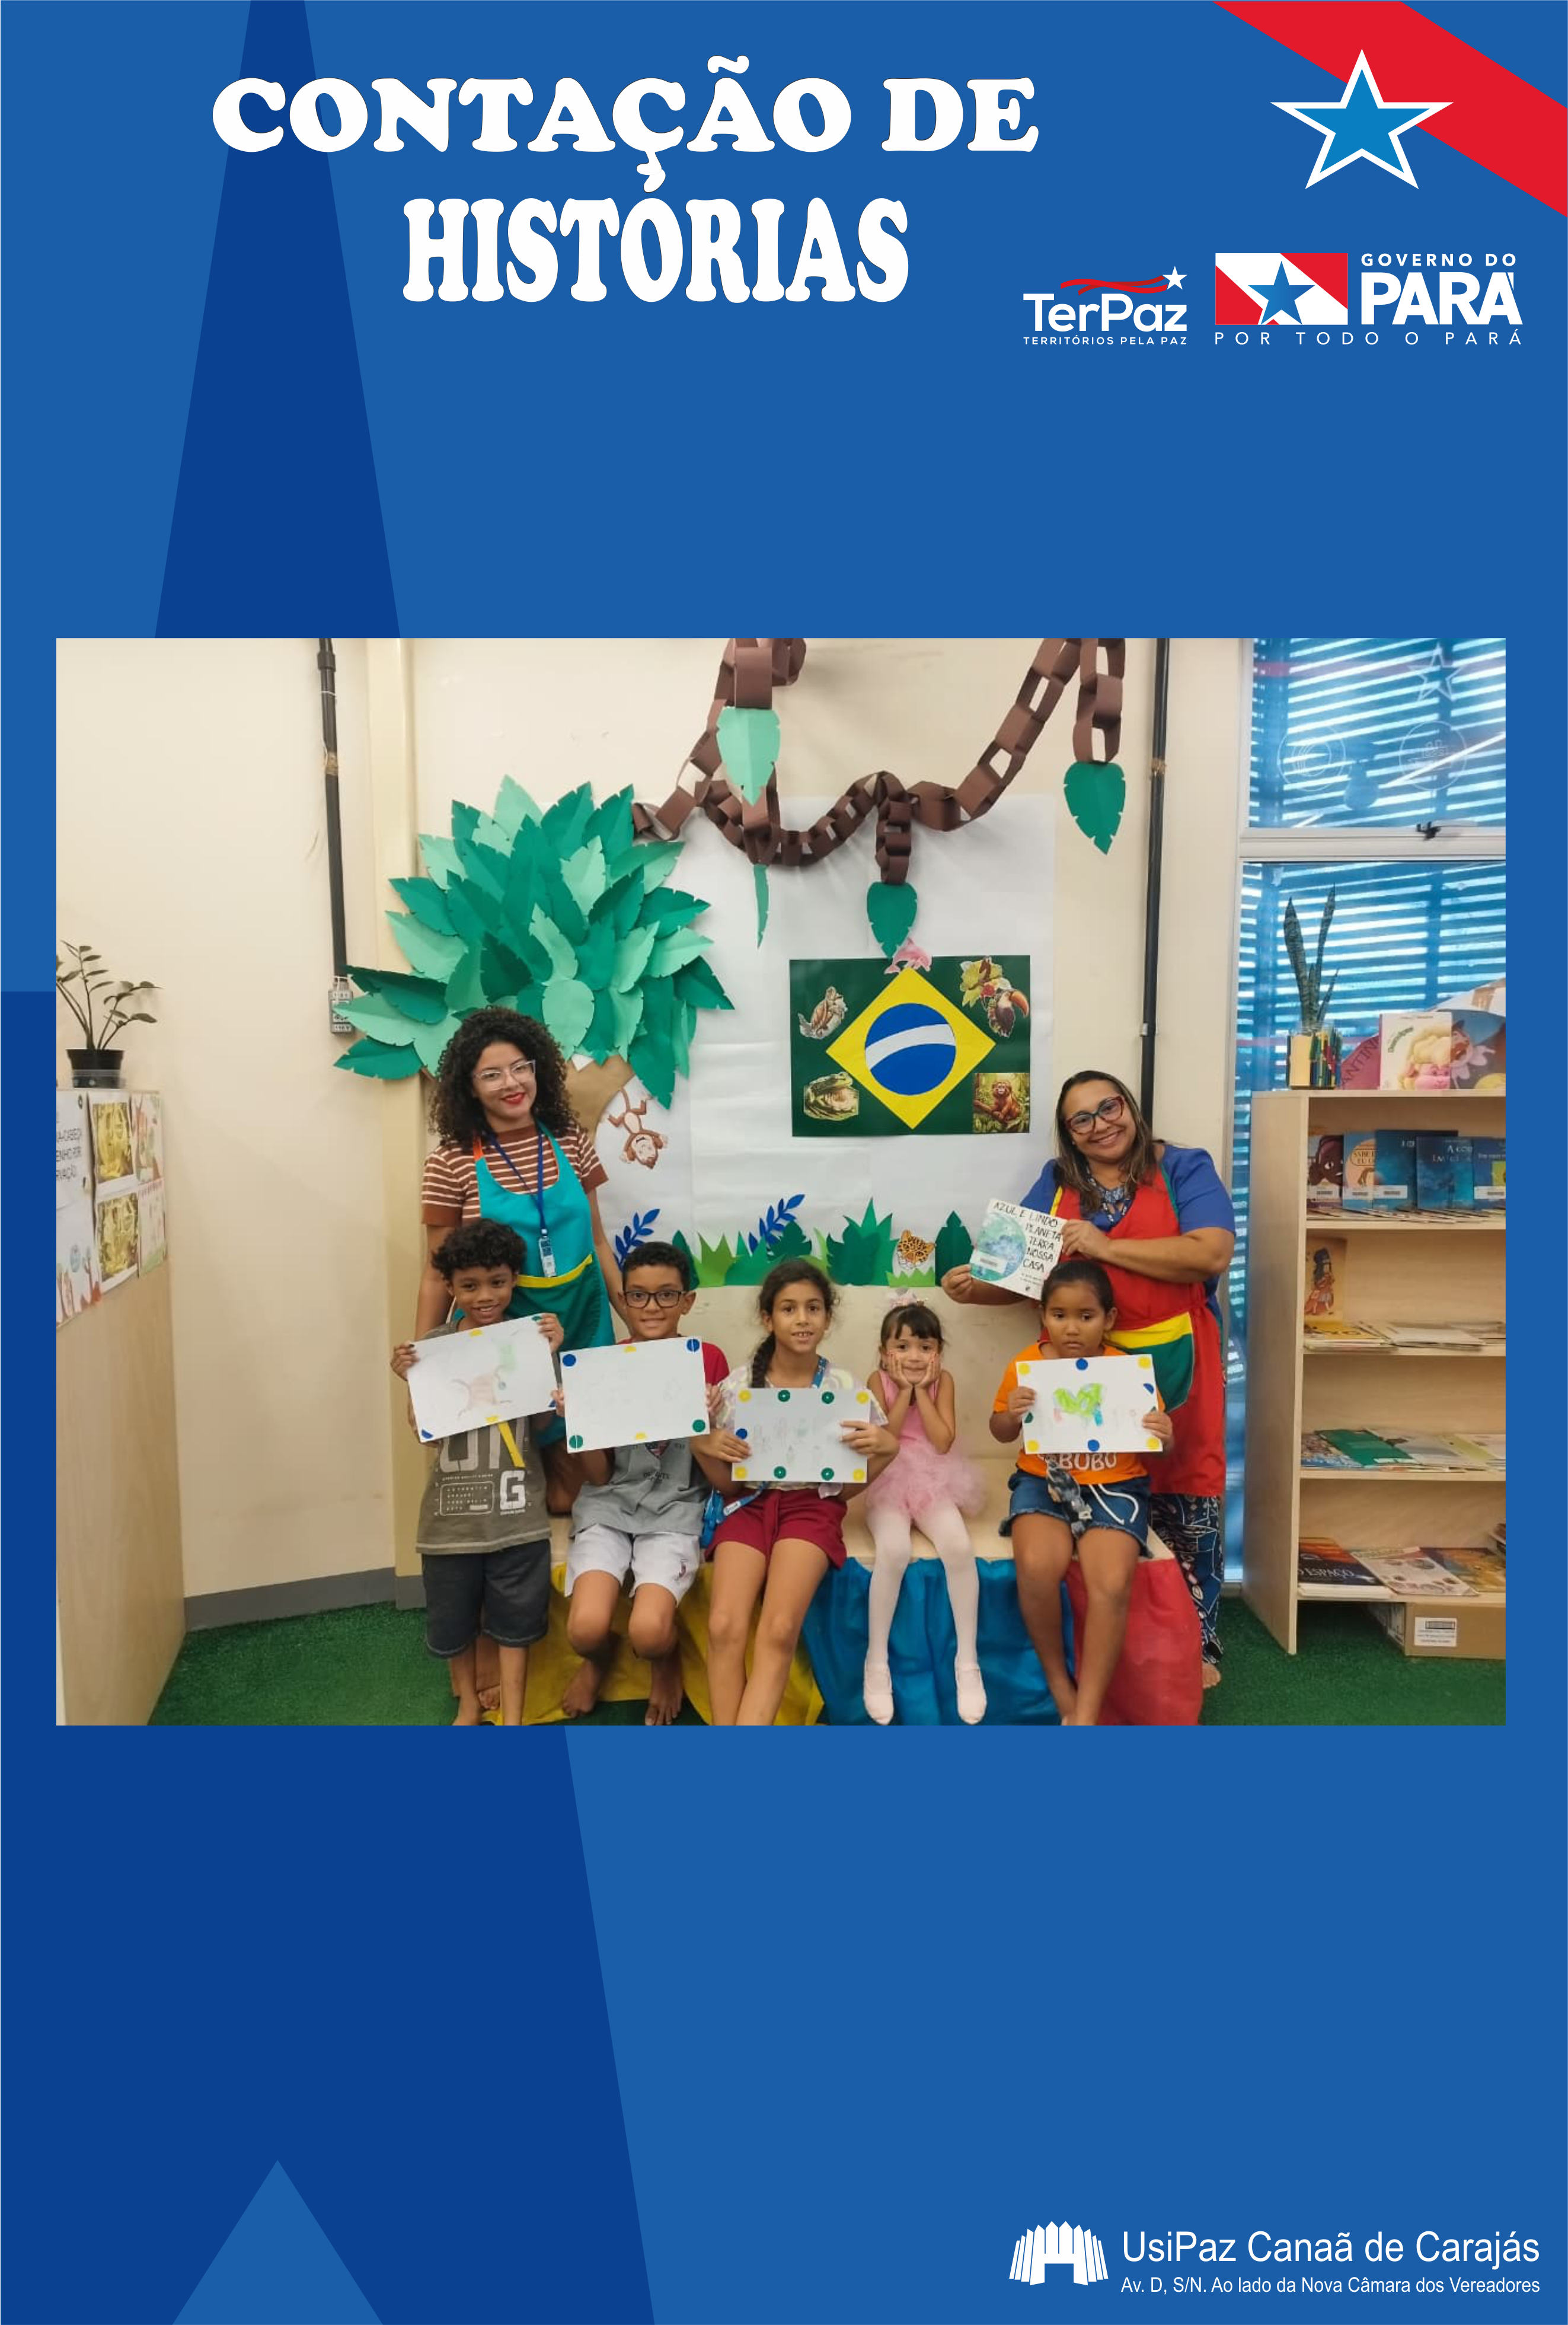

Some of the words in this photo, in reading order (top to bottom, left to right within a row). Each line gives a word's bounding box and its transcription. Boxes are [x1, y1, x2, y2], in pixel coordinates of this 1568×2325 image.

[994, 1202, 1017, 1215] AZUL
[1029, 1213, 1058, 1227] LINDO
[1026, 1223, 1061, 1242] PLANETA
[1029, 1235, 1054, 1250] TERRA
[1026, 1248, 1053, 1262] NOSSA
[1023, 1258, 1045, 1273] CASA
[500, 1470, 526, 1510] G
